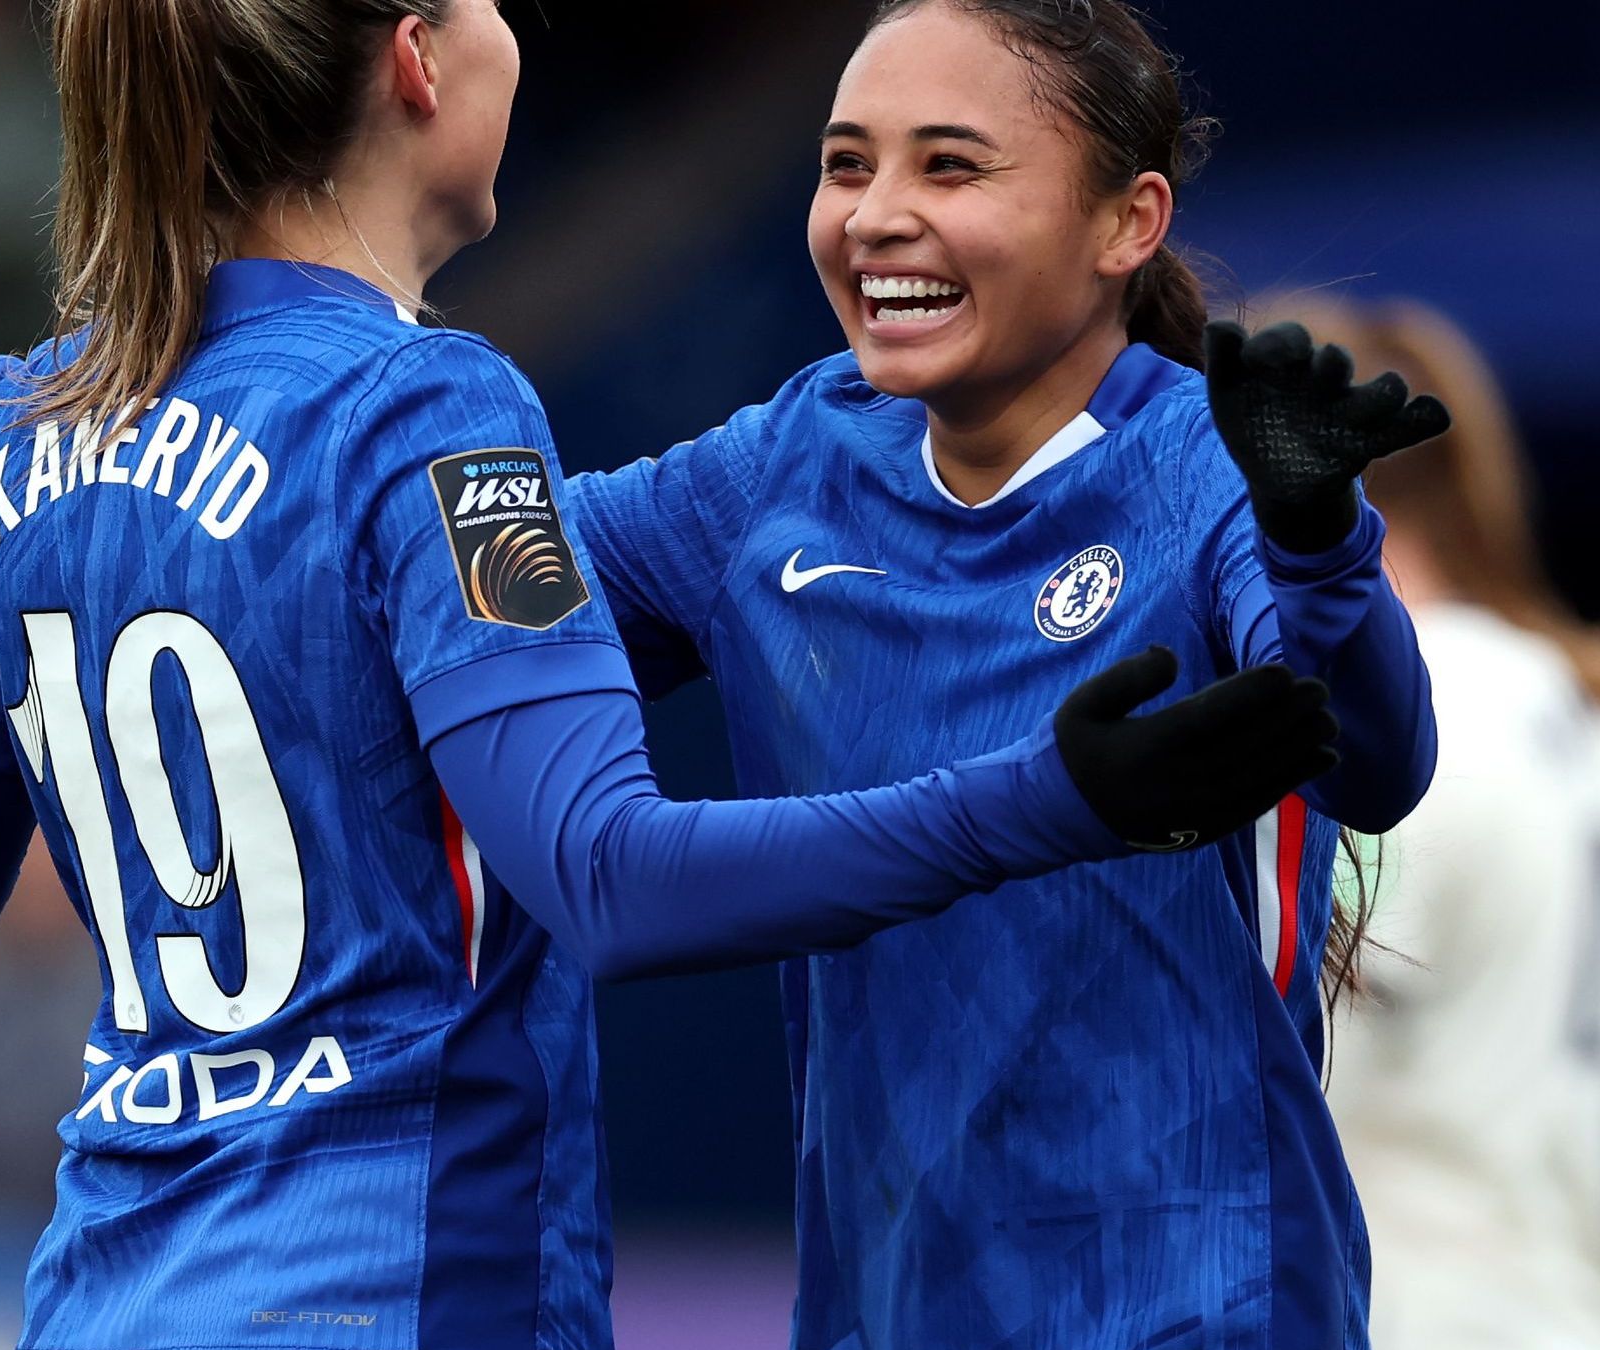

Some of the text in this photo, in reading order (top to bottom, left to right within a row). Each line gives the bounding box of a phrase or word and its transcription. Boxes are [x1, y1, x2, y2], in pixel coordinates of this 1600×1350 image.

[481, 461, 539, 474] BARCLAYS
[454, 477, 548, 516] WSL
[456, 511, 552, 529] CHAMPIONS 2024/25
[1070, 549, 1116, 571] CHELSEA
[7, 611, 306, 1034] 19
[75, 1036, 353, 1124] KODA
